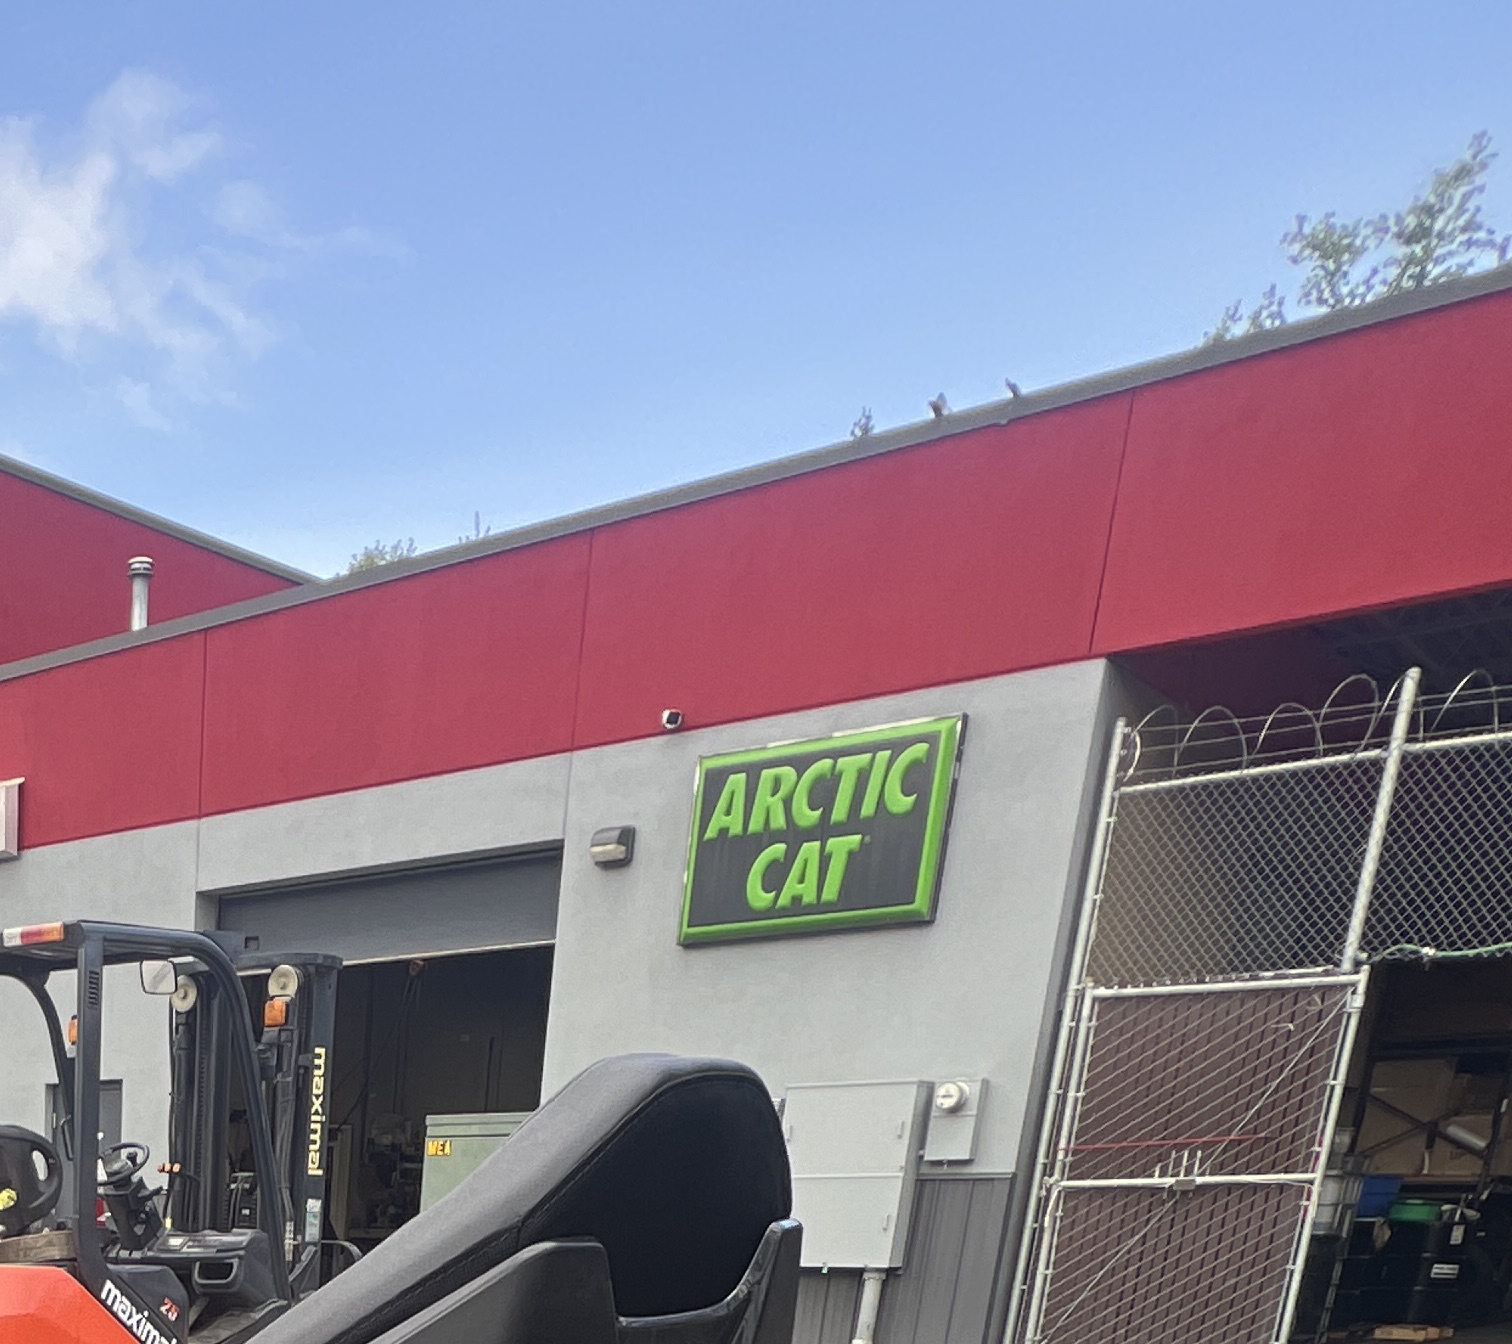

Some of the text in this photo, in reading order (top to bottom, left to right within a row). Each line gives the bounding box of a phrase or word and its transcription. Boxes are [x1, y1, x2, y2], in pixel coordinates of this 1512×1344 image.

[703, 742, 930, 842] ARCTIC
[746, 833, 863, 912] CAT
[307, 1047, 326, 1176] maximal
[160, 1296, 180, 1322] 25
